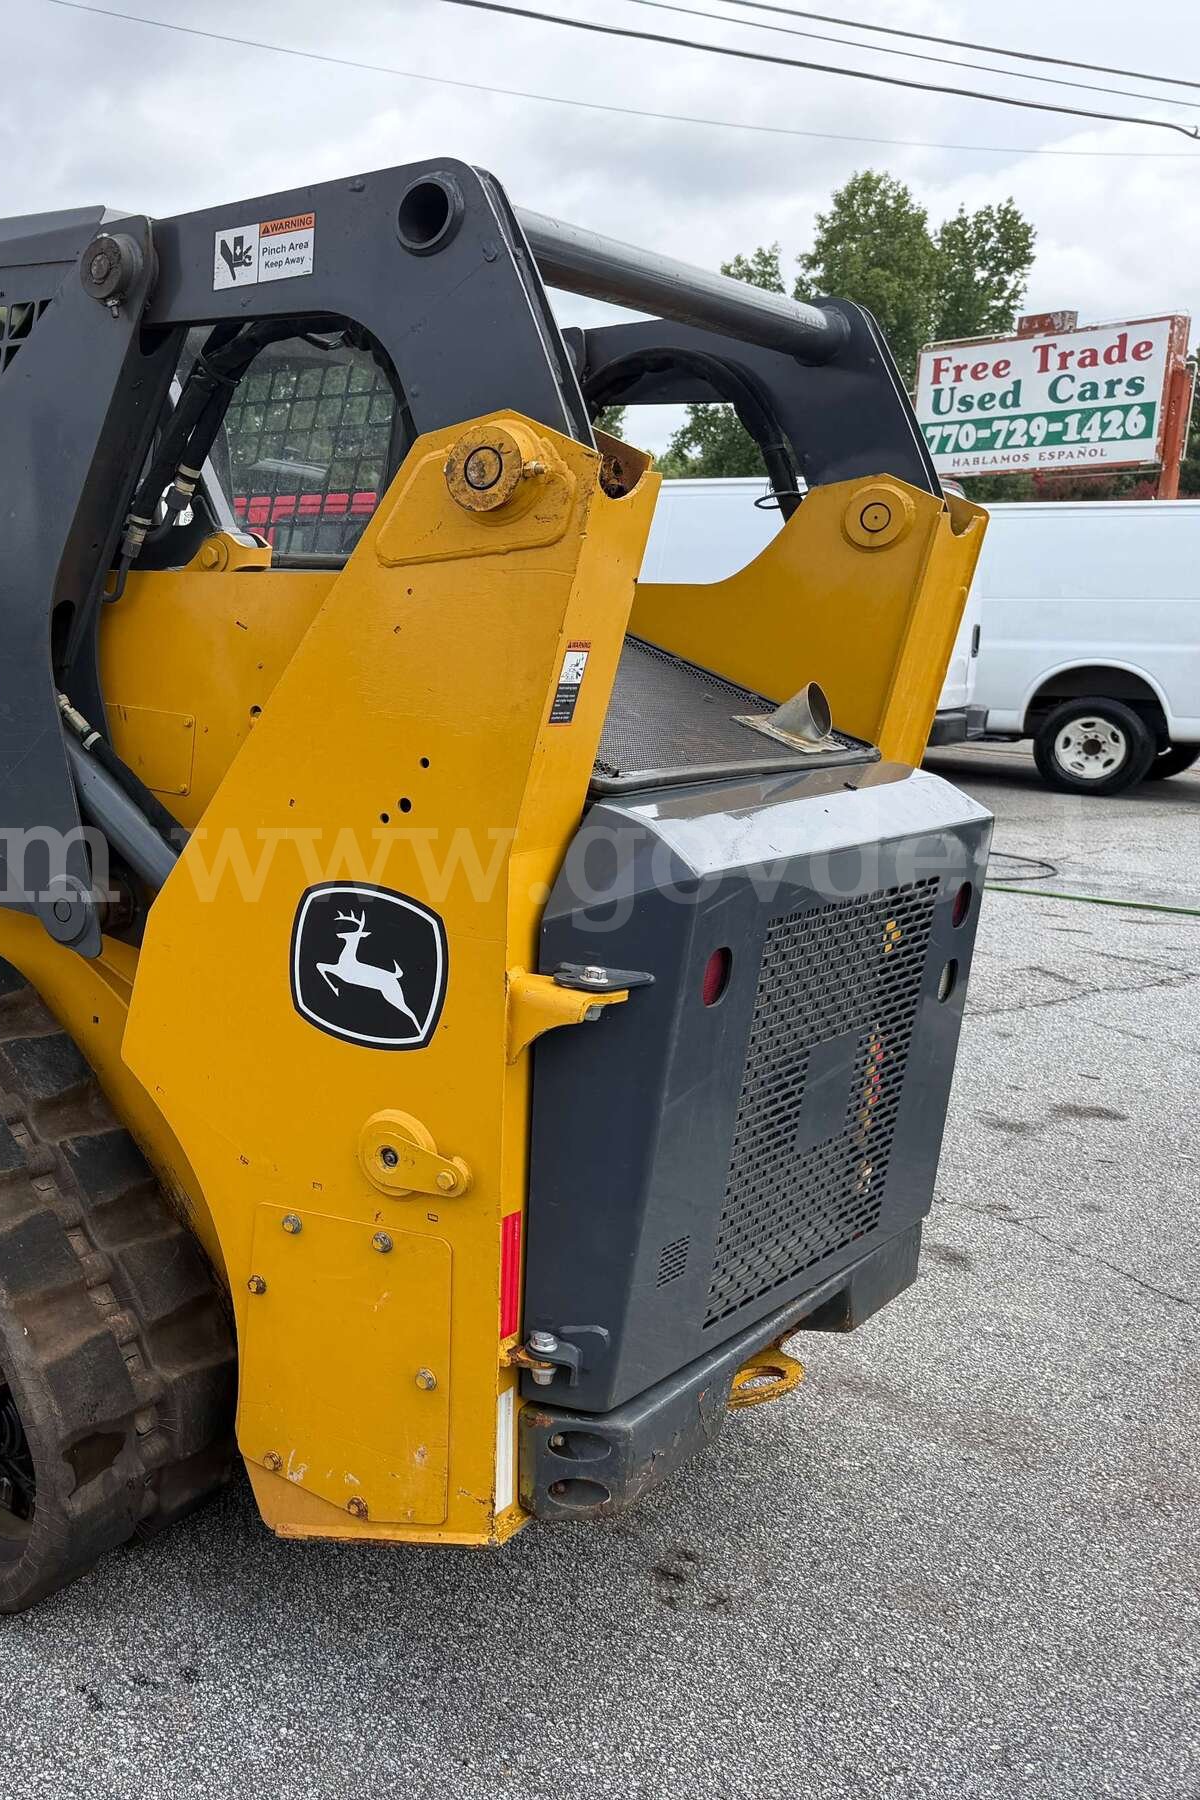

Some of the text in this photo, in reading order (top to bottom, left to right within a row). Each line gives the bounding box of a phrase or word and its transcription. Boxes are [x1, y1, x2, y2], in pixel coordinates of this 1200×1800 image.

[271, 216, 312, 232] WARNING
[262, 240, 309, 256] Pinch Area
[264, 255, 305, 269] Keep Away
[930, 333, 1153, 385] Free Trade
[932, 374, 1145, 415] Used Cars
[926, 405, 1146, 454] 770-729-1426
[952, 446, 1108, 467] HABLAMOS ESPAÑOL
